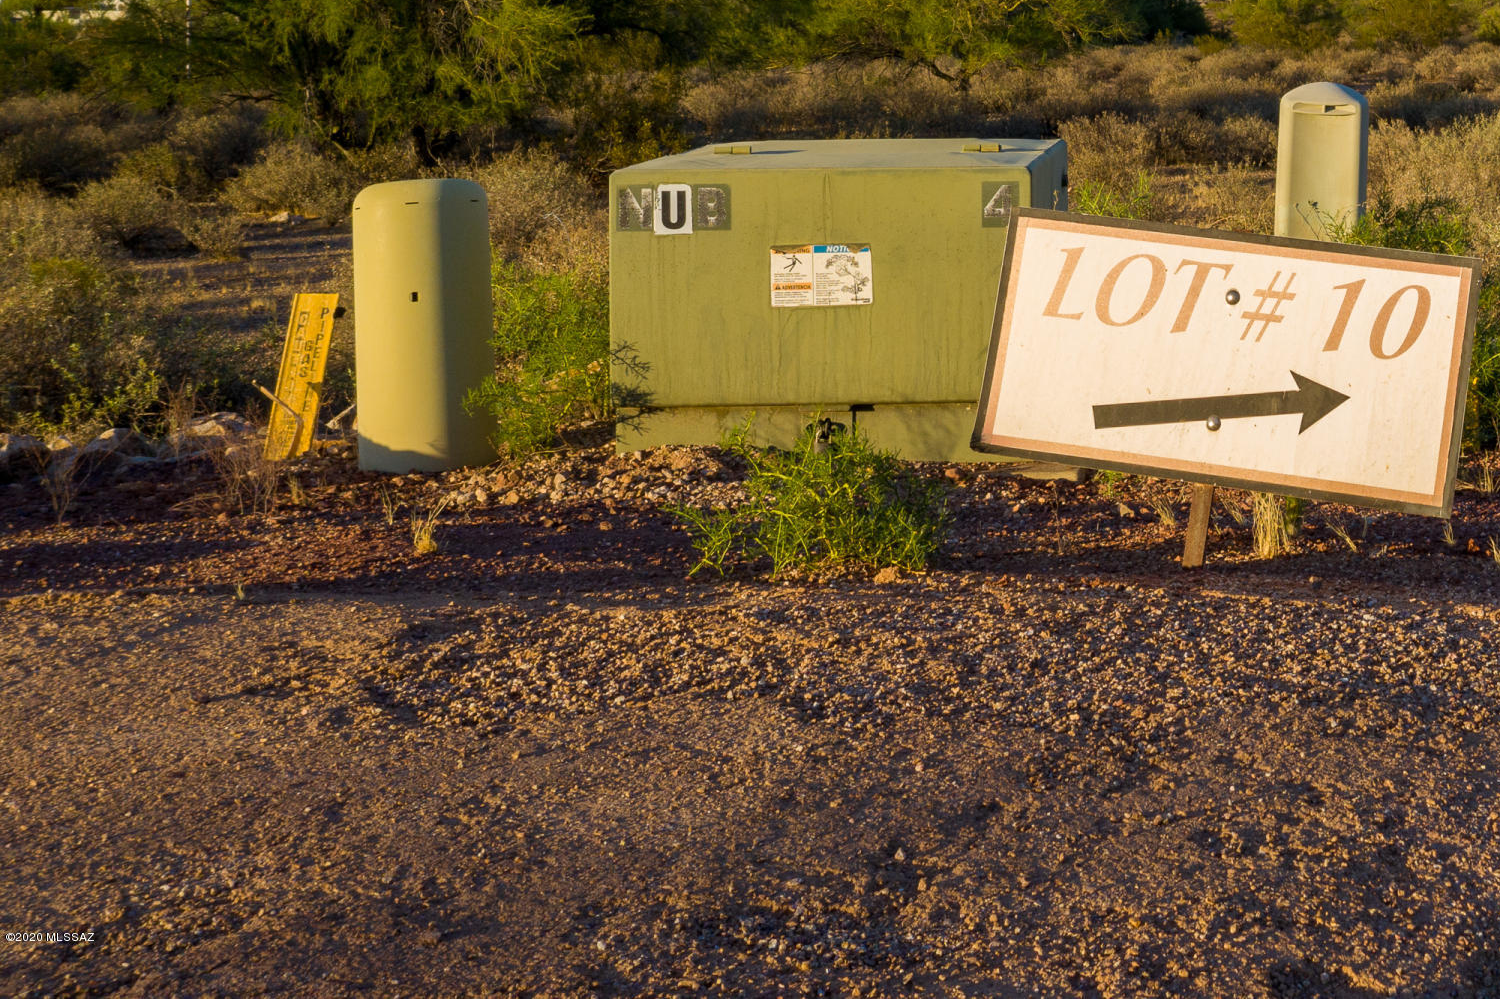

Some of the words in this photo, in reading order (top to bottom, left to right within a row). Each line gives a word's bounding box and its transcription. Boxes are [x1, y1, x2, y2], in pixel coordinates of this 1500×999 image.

[984, 185, 1012, 223] 4
[826, 245, 850, 253] NOTI
[1042, 246, 1234, 334] LOT
[1241, 271, 1296, 343] #
[1322, 278, 1431, 360] 10
[299, 340, 313, 378] GAS
